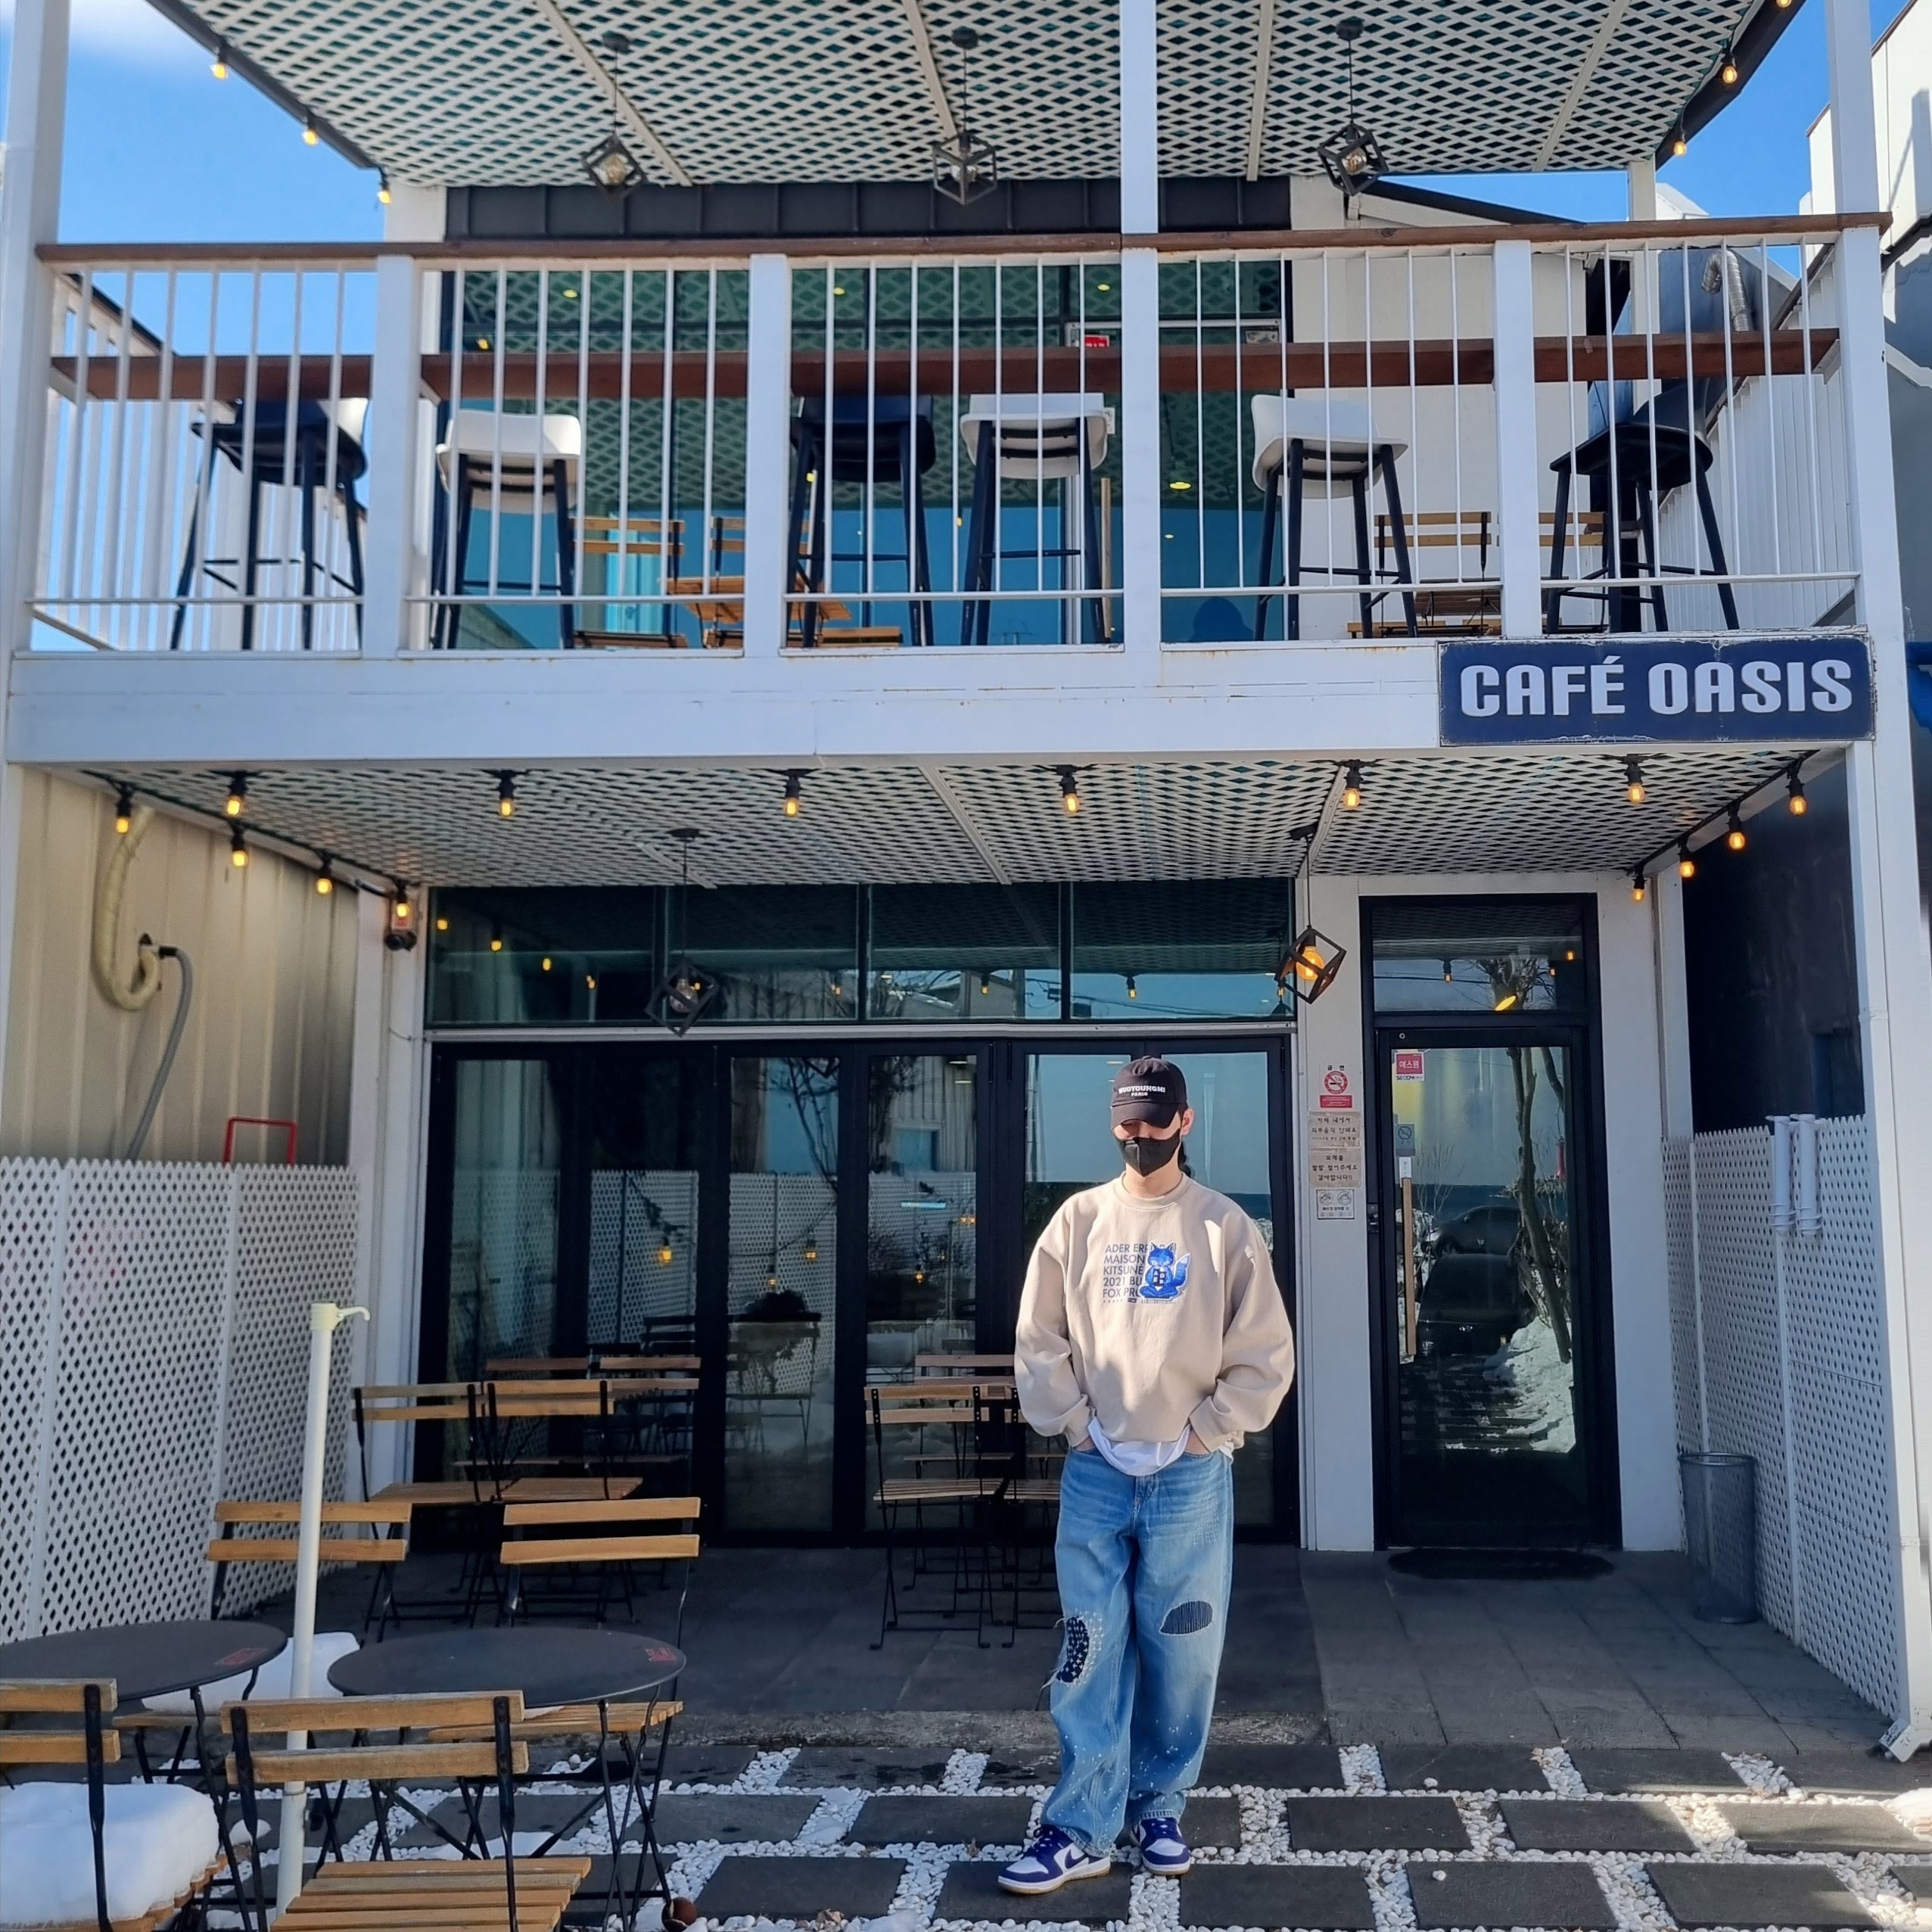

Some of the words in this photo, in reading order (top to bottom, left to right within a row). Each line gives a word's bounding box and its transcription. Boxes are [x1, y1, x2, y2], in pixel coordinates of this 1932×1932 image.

[1460, 655, 1626, 717] CAFÉ
[1647, 659, 1853, 715] OASIS
[1398, 1059, 1420, 1069] 에스원
[1105, 1243, 1130, 1253] ADER
[1103, 1254, 1145, 1264] MAISON
[1103, 1277, 1125, 1286] 2021
[1103, 1288, 1122, 1298] FOX
